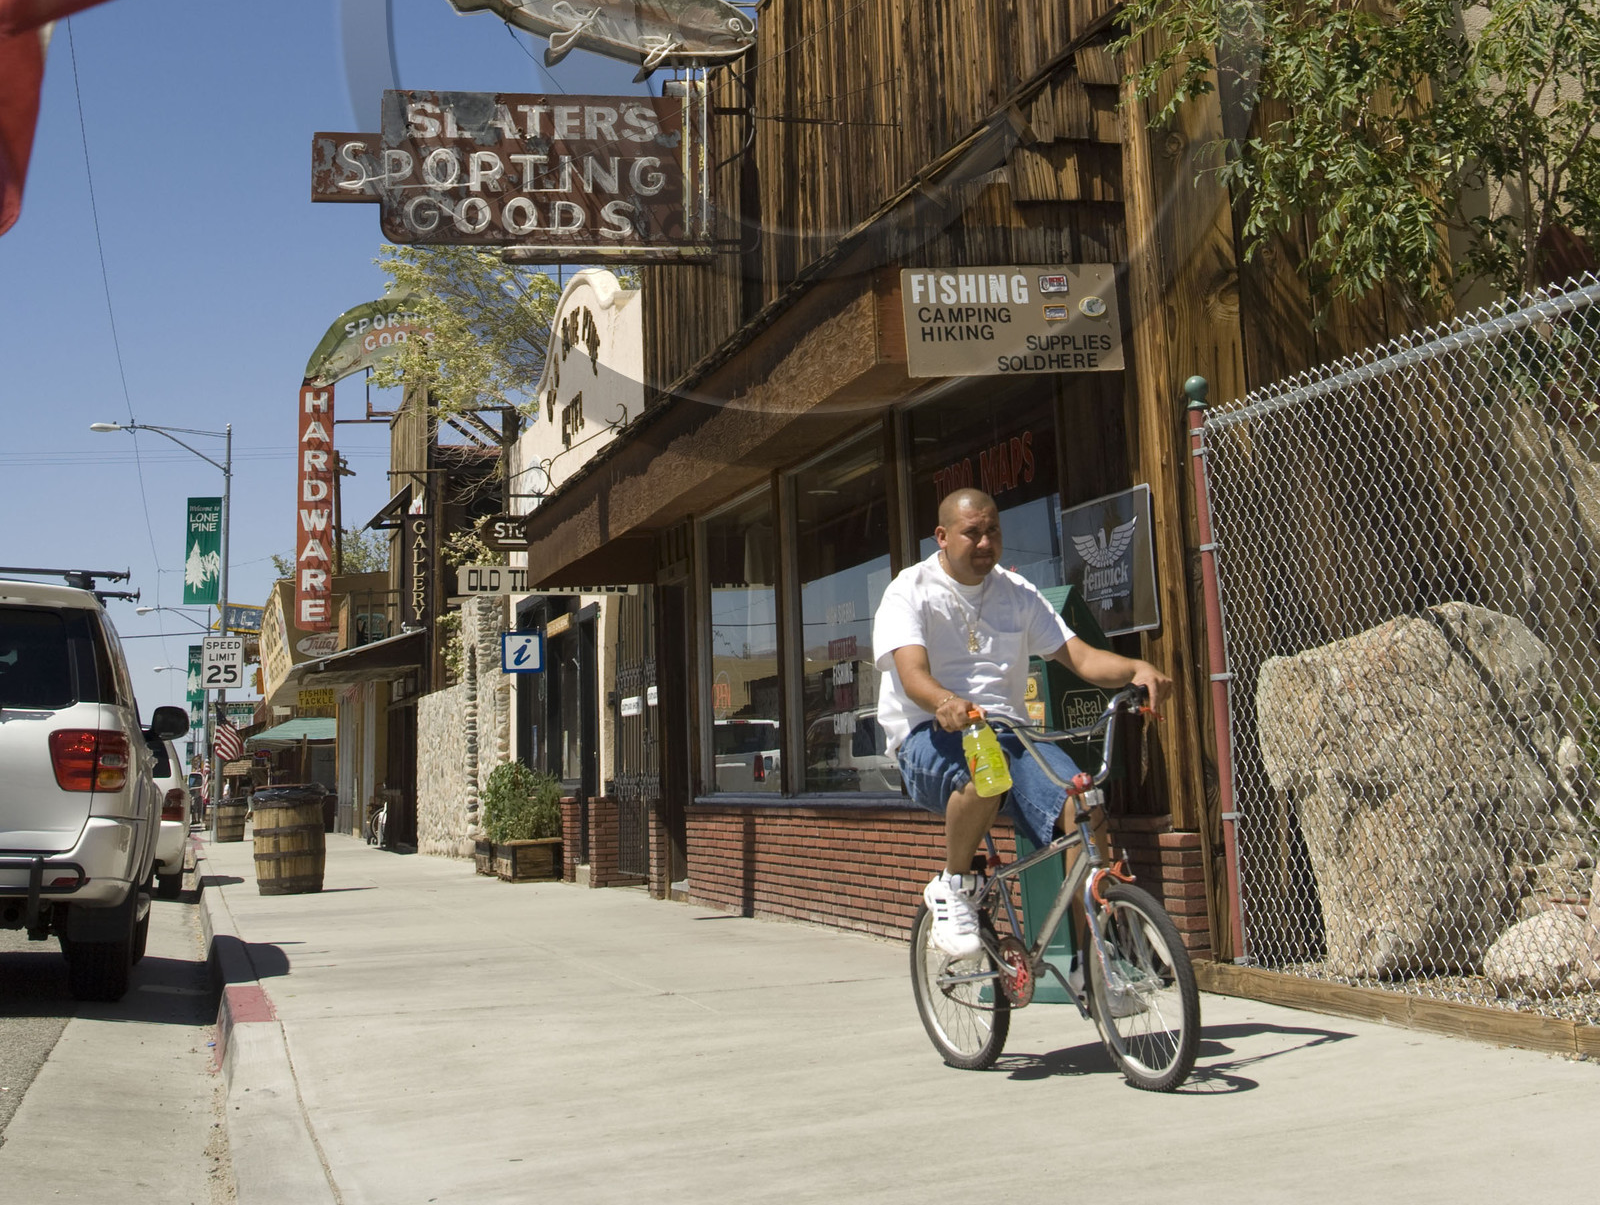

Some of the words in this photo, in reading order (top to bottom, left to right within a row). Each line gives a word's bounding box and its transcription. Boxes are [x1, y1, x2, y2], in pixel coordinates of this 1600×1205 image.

[338, 142, 665, 195] SPORTING
[402, 196, 635, 238] GOODS
[910, 274, 1029, 305] FISHING
[918, 307, 1011, 323] CAMPING
[921, 325, 994, 342] HIKING
[1026, 335, 1111, 352] SUPPLIES
[980, 430, 1035, 496] MAPS
[189, 512, 219, 522] LONE
[299, 392, 330, 623] HARDWARE
[191, 522, 217, 532] PINE
[412, 520, 427, 621] GALLERY
[467, 569, 500, 592] OLD
[1082, 561, 1129, 602] fenwick
[206, 641, 241, 650] SPEED
[209, 653, 237, 662] LIMIT
[206, 664, 238, 684] 25
[298, 688, 334, 697] FISHING
[299, 697, 334, 705] TACKLE
[1073, 695, 1103, 716] Real
[1067, 713, 1099, 731] Estat
